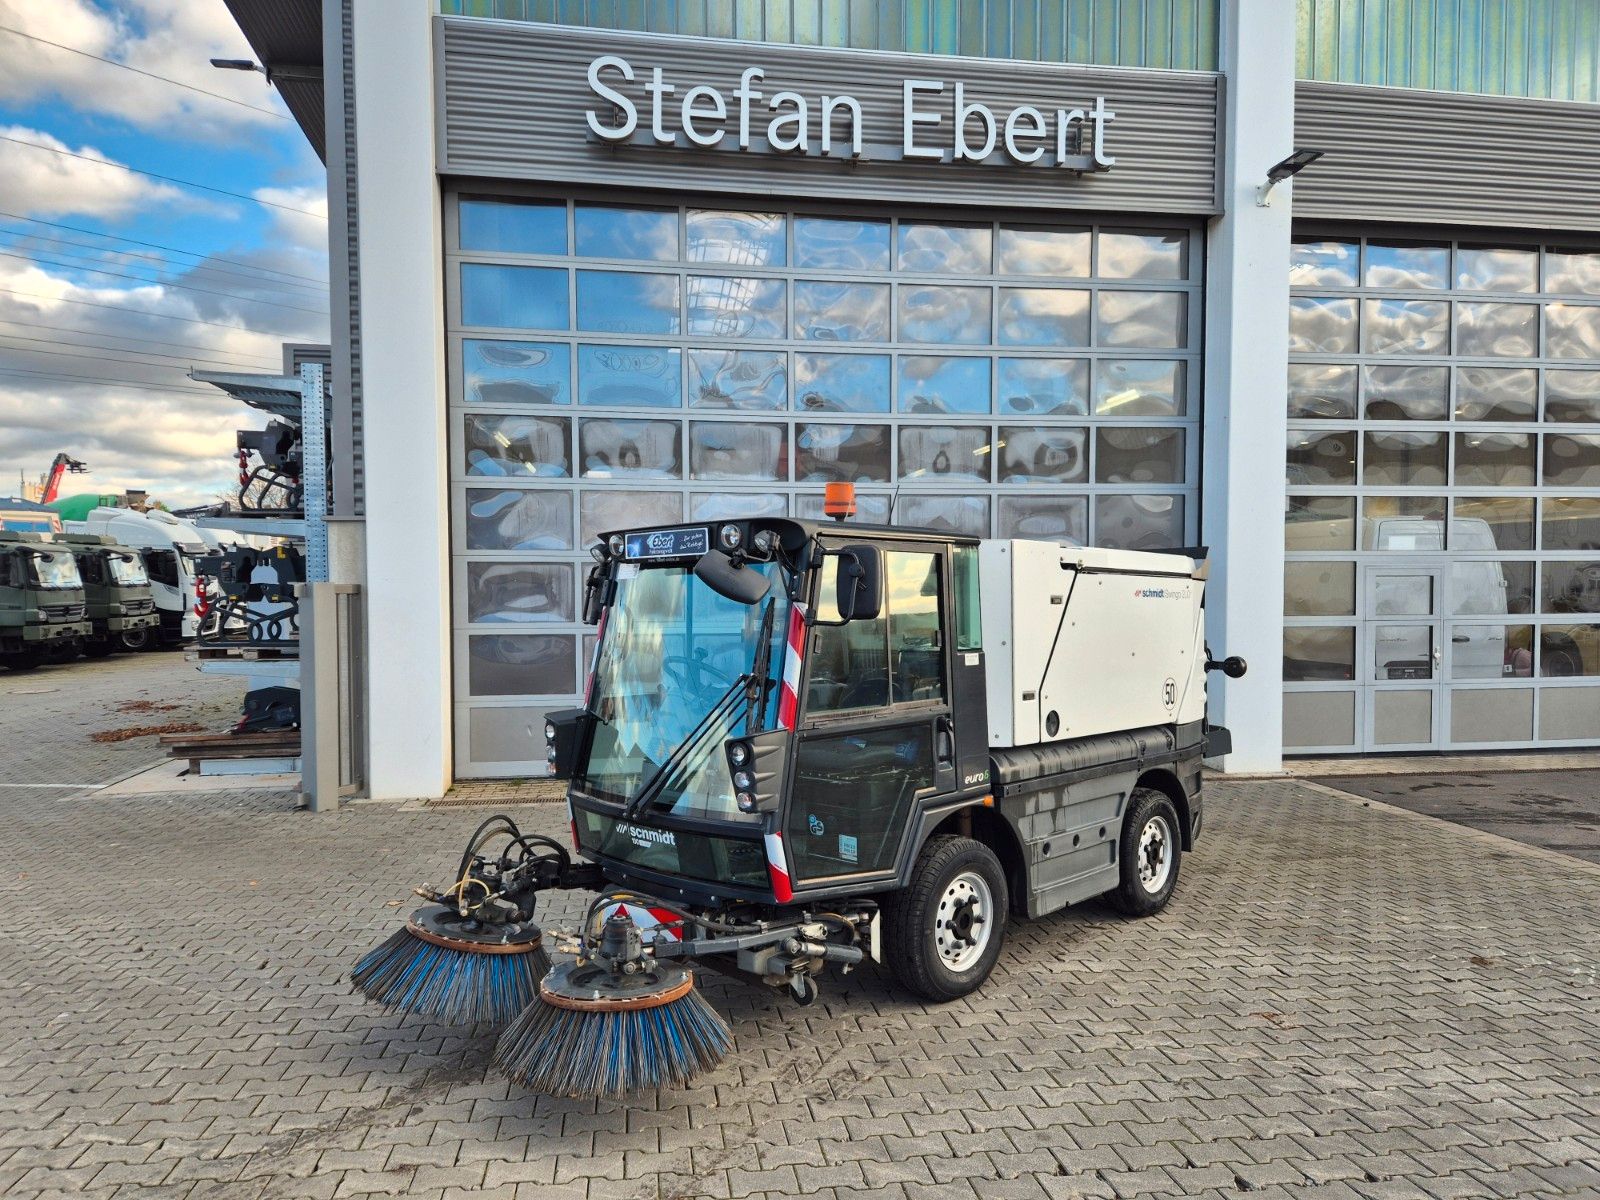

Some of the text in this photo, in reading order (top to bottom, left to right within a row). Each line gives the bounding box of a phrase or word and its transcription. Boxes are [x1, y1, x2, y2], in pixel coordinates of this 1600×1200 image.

[586, 56, 1116, 172] Stefan Ebert
[648, 533, 674, 548] Ebert
[1142, 588, 1164, 598] schmidt
[1165, 683, 1175, 706] 50
[630, 826, 676, 846] schmidt
